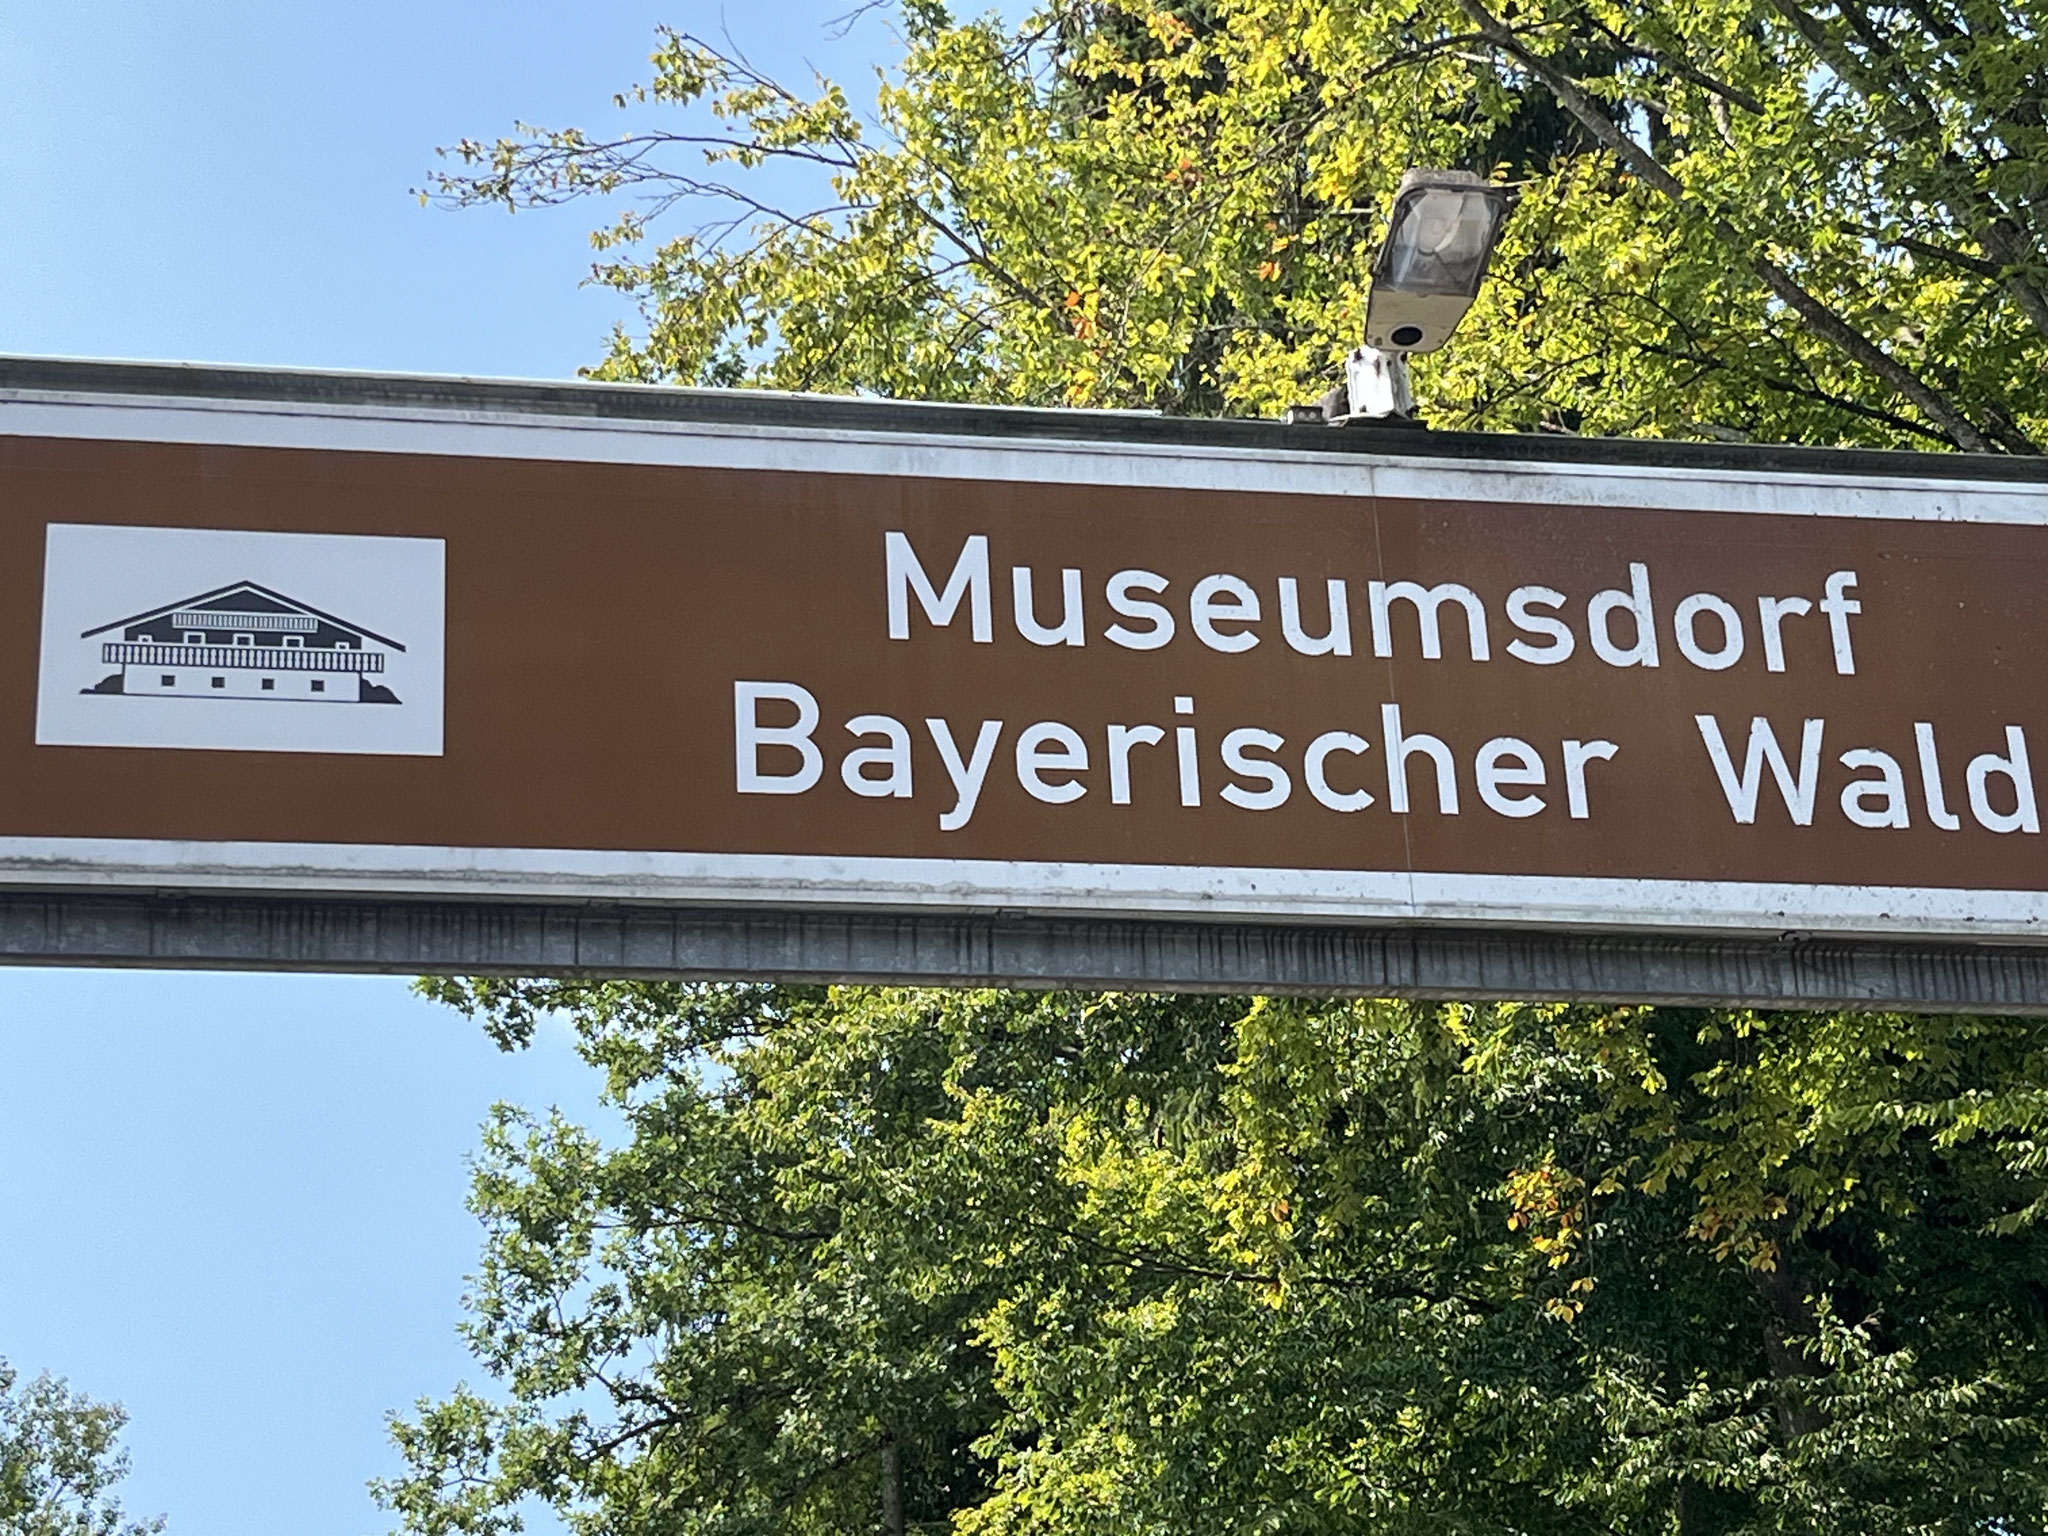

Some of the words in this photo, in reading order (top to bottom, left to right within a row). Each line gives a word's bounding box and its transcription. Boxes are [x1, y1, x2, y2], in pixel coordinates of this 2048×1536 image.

[884, 531, 1862, 675] Museumsdorf
[733, 680, 1620, 831] Bayerischer
[1694, 714, 2041, 834] Wald
